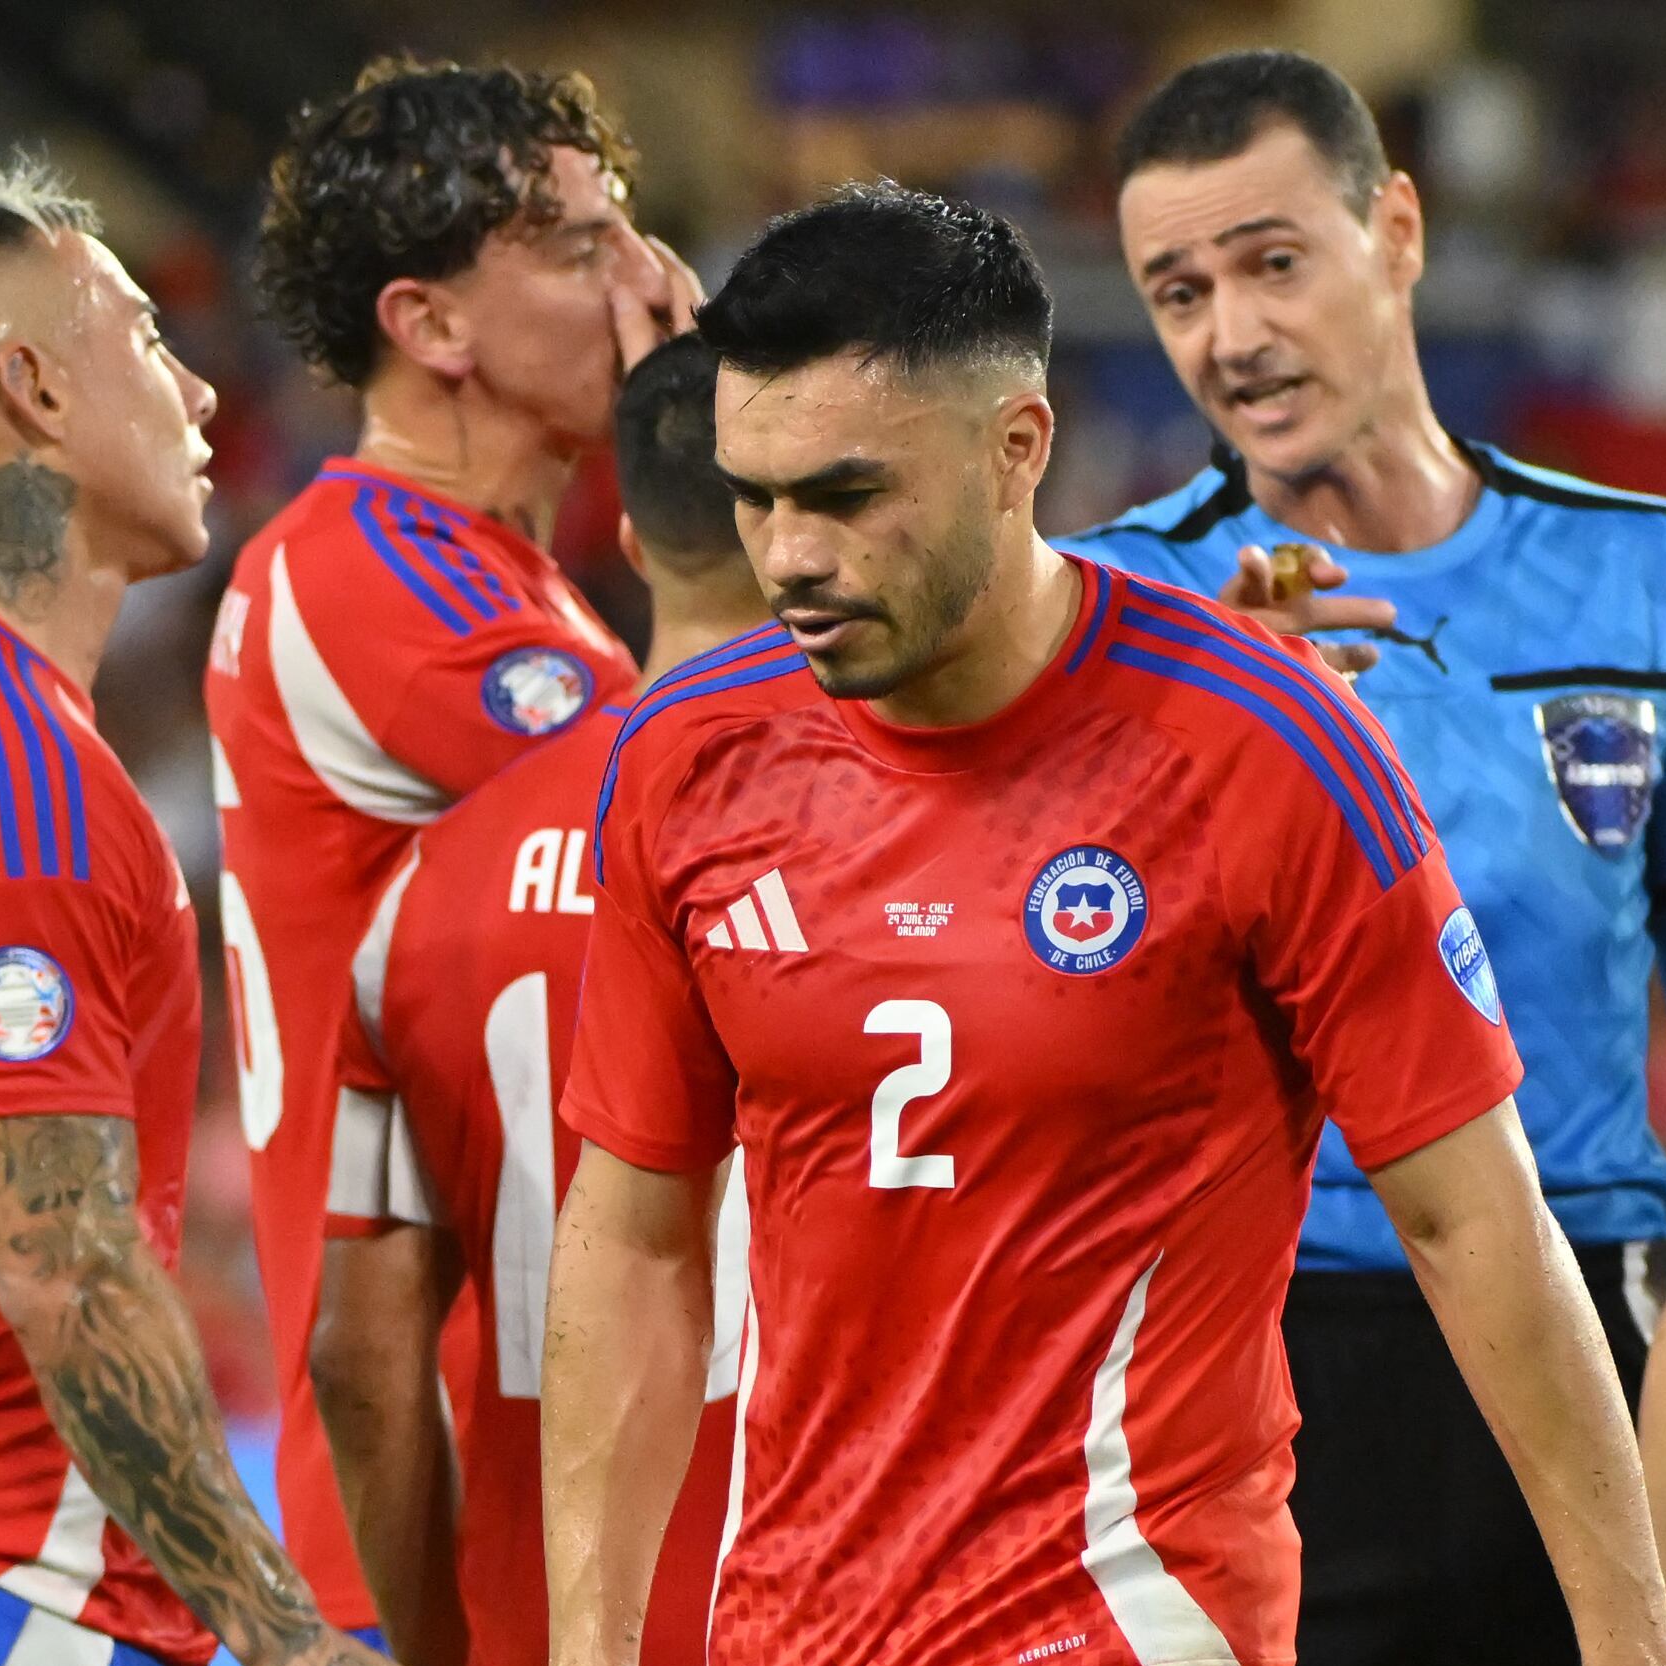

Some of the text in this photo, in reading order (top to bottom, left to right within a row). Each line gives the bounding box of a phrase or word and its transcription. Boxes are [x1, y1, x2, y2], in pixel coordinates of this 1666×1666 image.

[1028, 850, 1145, 914] FEDERACION DE FUTBOL
[884, 902, 919, 914] CANADA
[929, 903, 955, 914] CHILE
[887, 914, 948, 926] 29 JUNE 2024
[897, 925, 937, 937] ORLANDO
[1050, 948, 1114, 970] DE CHILE
[863, 999, 955, 1189] 2
[1018, 1633, 1087, 1665] AEROREADY
